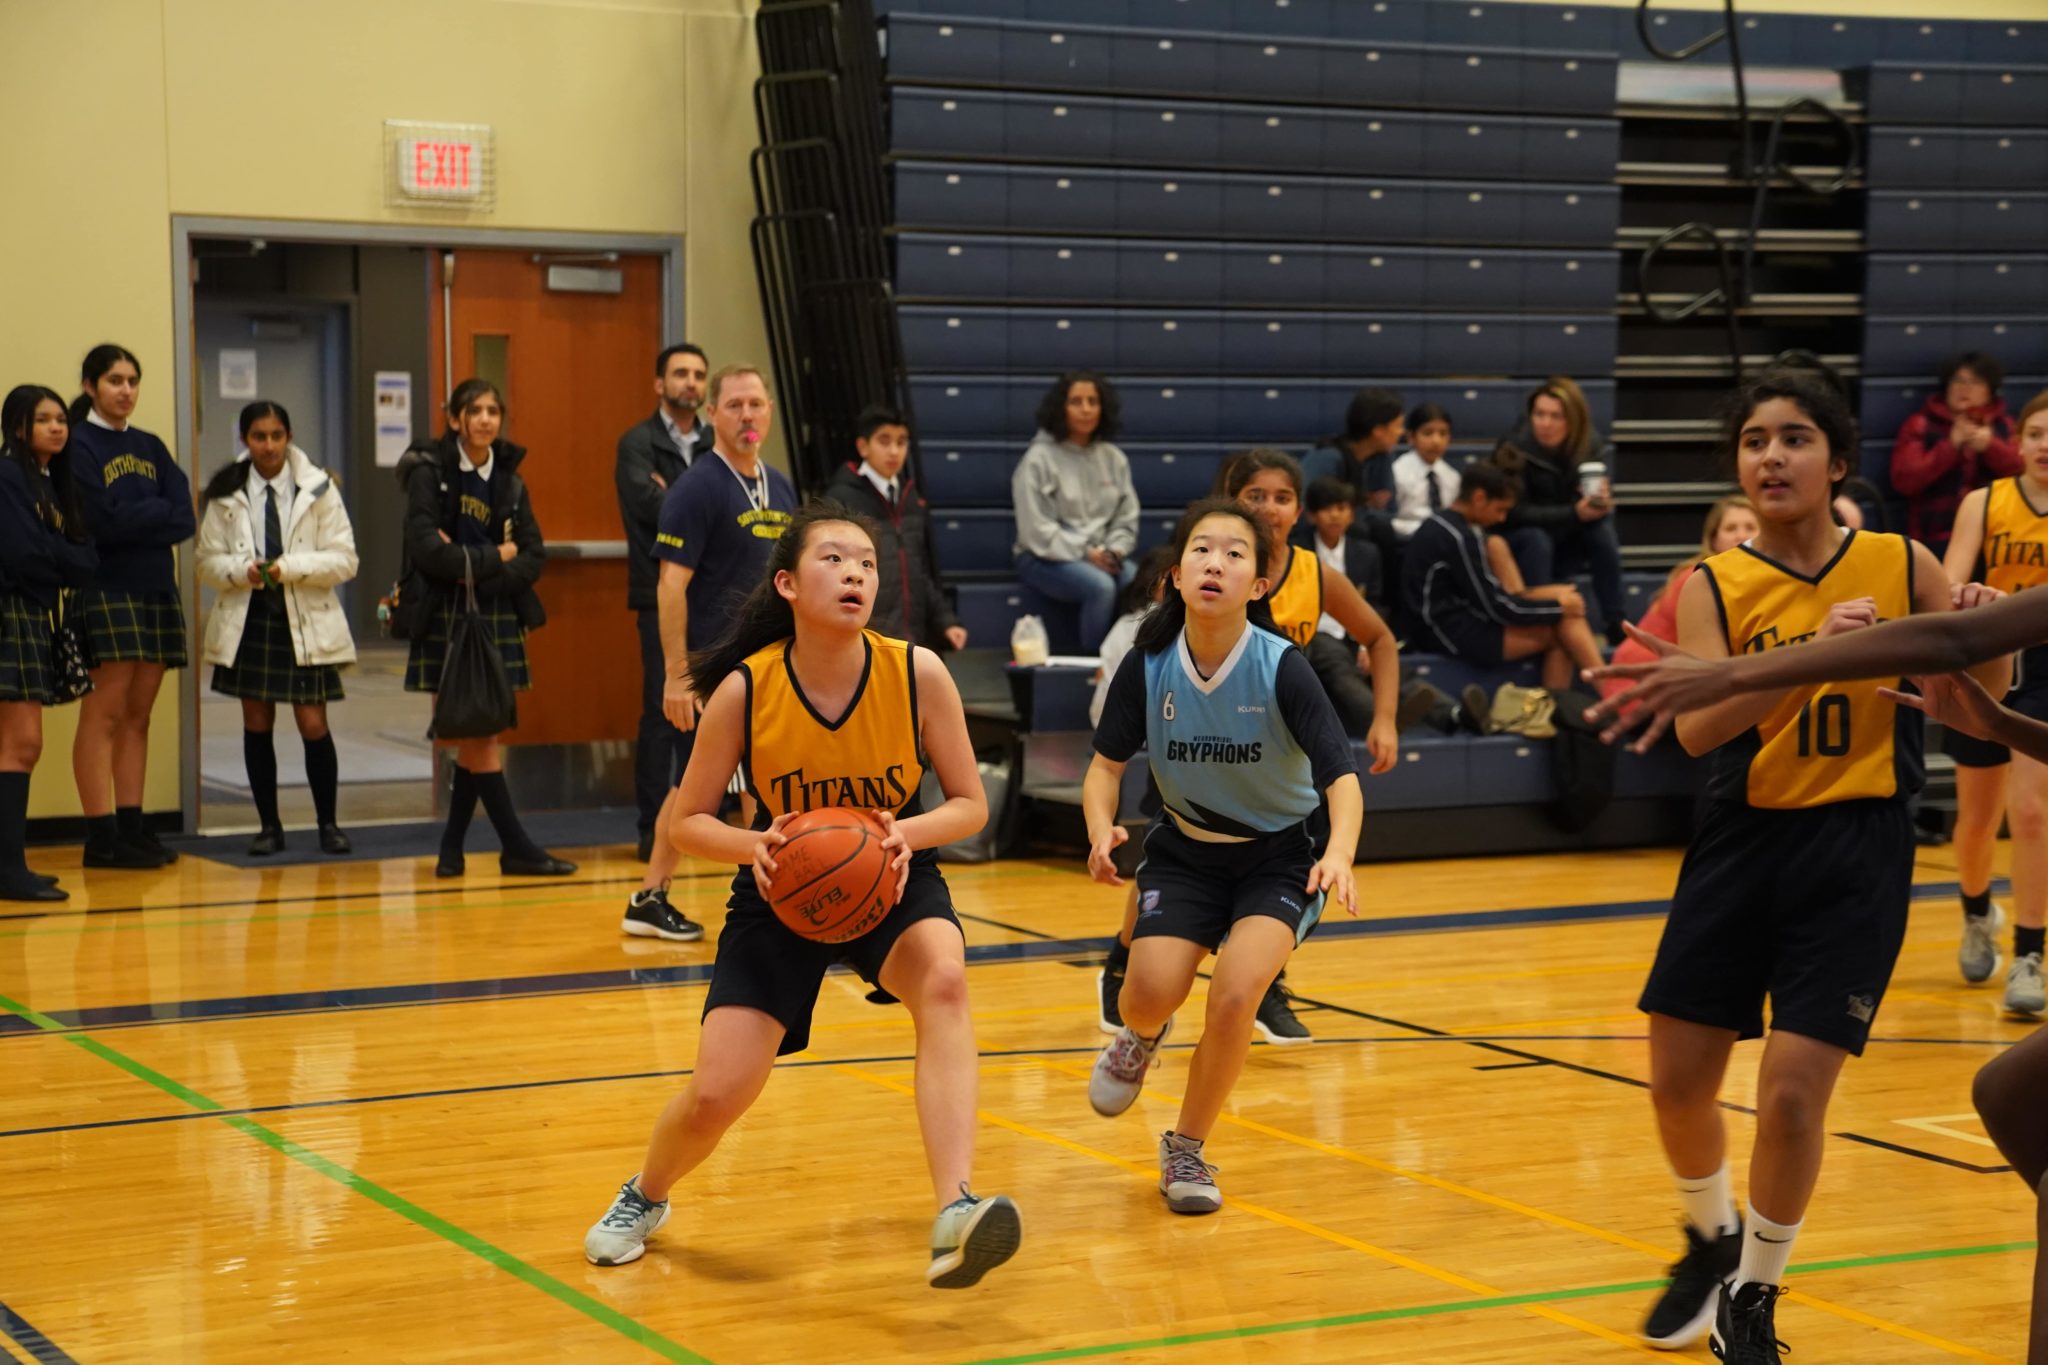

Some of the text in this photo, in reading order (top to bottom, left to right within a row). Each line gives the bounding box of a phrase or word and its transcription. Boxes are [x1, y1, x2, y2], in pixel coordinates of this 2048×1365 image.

[415, 141, 472, 188] EXIT
[1163, 691, 1176, 721] 6
[1797, 693, 1850, 758] 10
[1166, 740, 1263, 765] GRYPHONS
[770, 764, 908, 814] TITANS
[799, 885, 845, 919] ELITE
